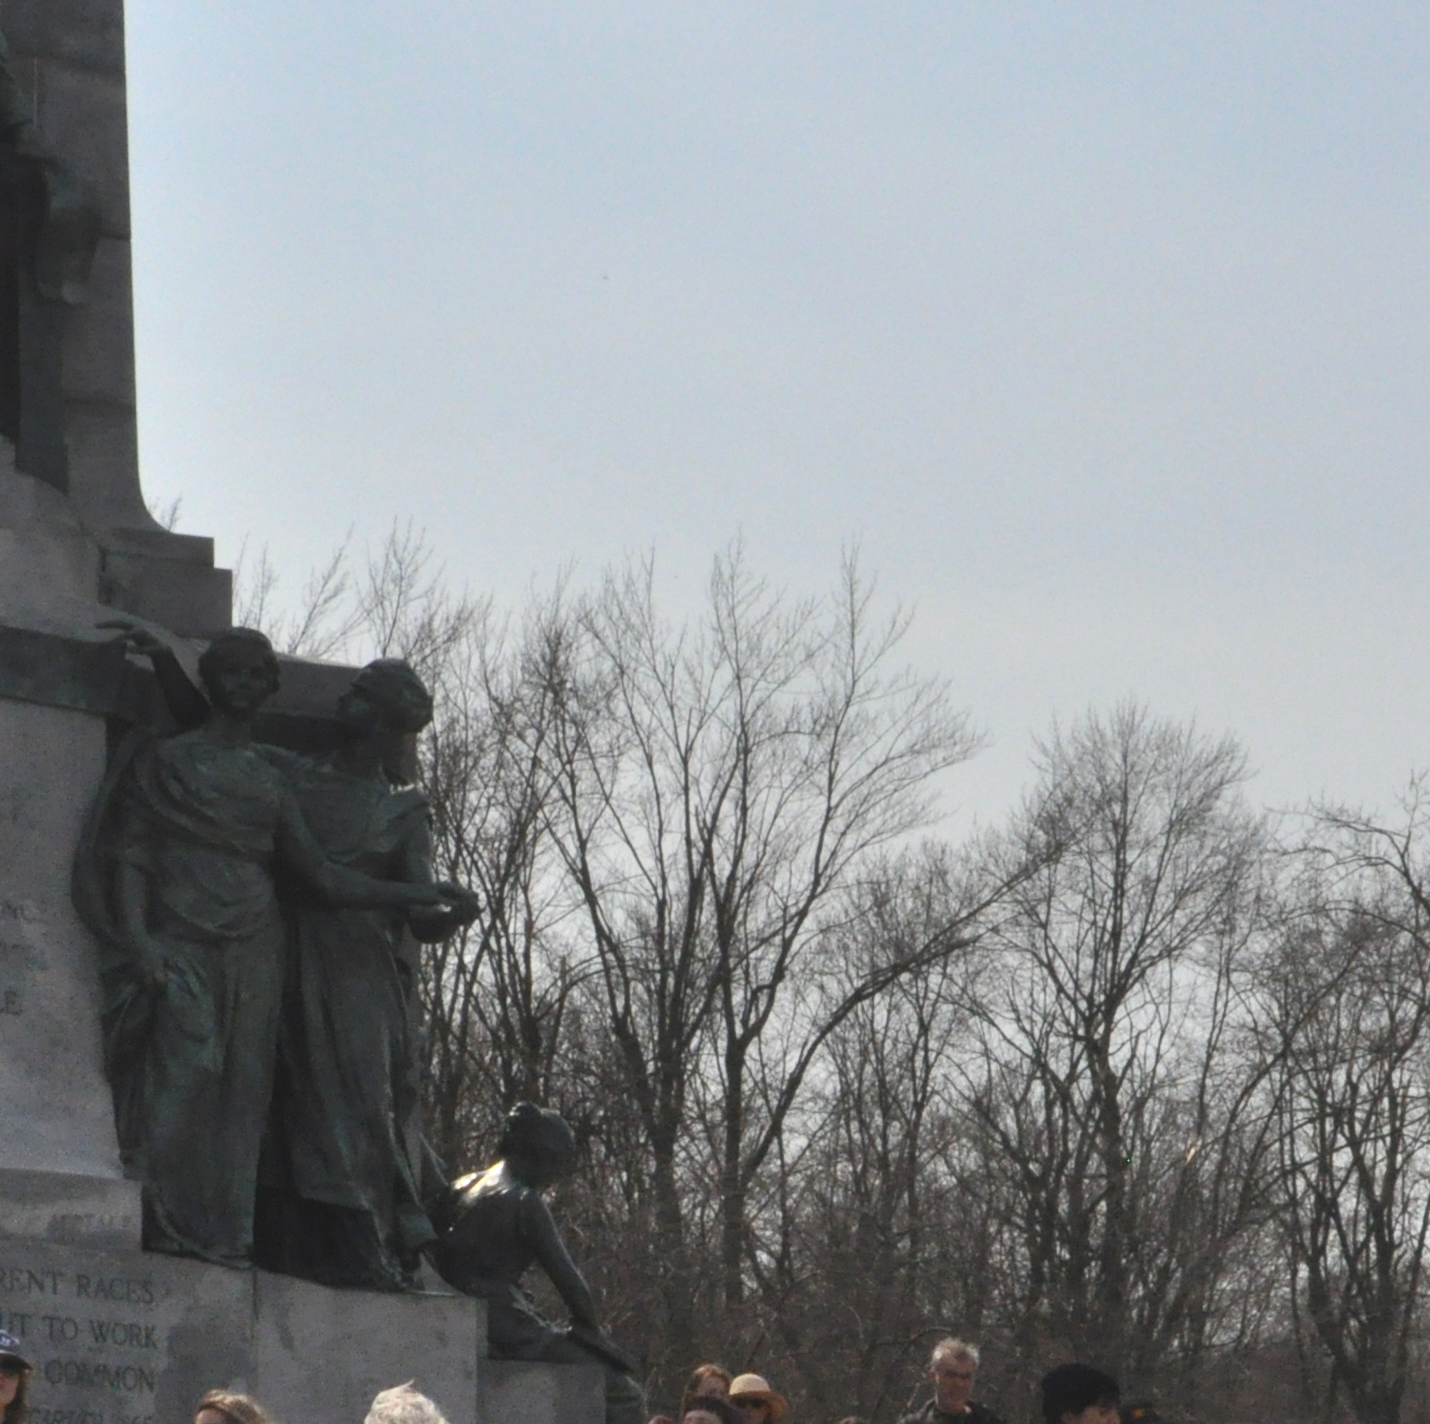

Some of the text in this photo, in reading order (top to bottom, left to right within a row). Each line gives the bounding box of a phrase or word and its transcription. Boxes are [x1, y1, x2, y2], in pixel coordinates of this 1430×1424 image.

[75, 1272, 155, 1306] RACES
[41, 1313, 79, 1342] TO
[88, 1317, 159, 1350] WORK
[44, 1359, 156, 1393] COMMON
